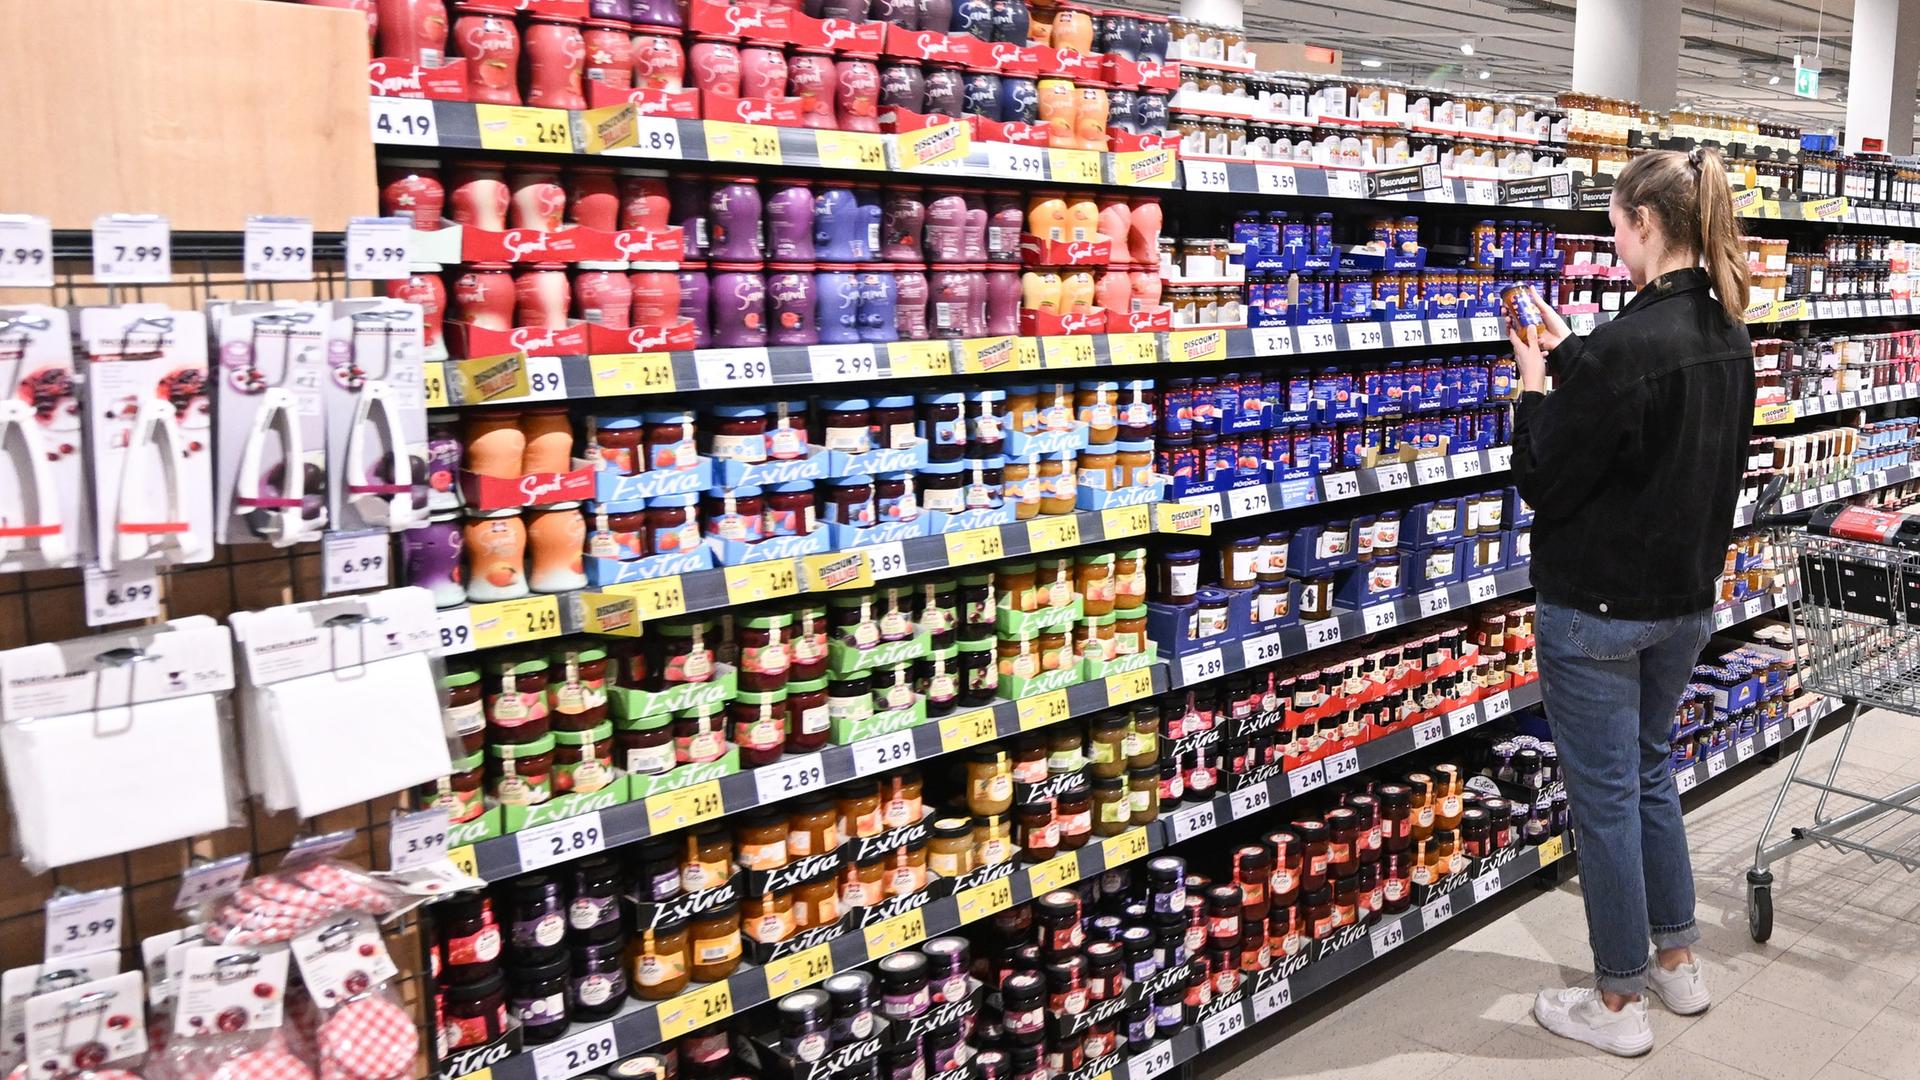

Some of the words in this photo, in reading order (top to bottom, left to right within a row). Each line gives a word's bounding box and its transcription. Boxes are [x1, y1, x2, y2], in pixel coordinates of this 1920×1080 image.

[726, 9, 762, 34] Samt
[823, 20, 855, 48] Samt
[918, 28, 949, 58] Samt
[992, 39, 1019, 66] Samt
[1056, 49, 1082, 72] Samt
[737, 100, 774, 123] Samt
[377, 113, 430, 136] 4.19
[536, 123, 566, 144] 2.69
[753, 138, 777, 155] 2.69
[858, 144, 880, 163] 2.69
[1009, 155, 1039, 173] 2.99
[1081, 162, 1099, 177] 2.69
[1202, 172, 1225, 185] 3.59
[1272, 175, 1294, 188] 3.59
[1380, 173, 1418, 187] Besonderes
[1510, 184, 1547, 196] Besonderes
[114, 246, 162, 262] 7.99
[263, 246, 305, 262] 9.99
[365, 247, 404, 262] 9.99
[504, 231, 550, 261] Samt
[615, 231, 654, 261] Samt
[1068, 242, 1094, 264] Samt
[1061, 314, 1087, 335] Samt
[1129, 312, 1153, 332] Samt
[1482, 326, 1498, 336] 2.79
[510, 329, 555, 351] Samt
[1314, 335, 1333, 347] 3.19
[1362, 332, 1380, 343] 2.99
[1404, 330, 1422, 341] 2.79
[1441, 327, 1458, 339] 2.79
[1139, 343, 1153, 358] 2.69
[1268, 337, 1289, 349] 2.79
[927, 354, 947, 368] 2.69
[1019, 349, 1036, 364] 2.69
[1076, 346, 1092, 361] 2.69
[726, 361, 765, 380] 2.89
[836, 358, 872, 374] 2.99
[644, 367, 669, 385] 2.69
[1023, 432, 1082, 452] Extra
[842, 450, 917, 474] Extra
[1464, 460, 1478, 472] 3.19
[741, 462, 820, 485] Extra
[1389, 472, 1408, 485] 2.99
[1428, 467, 1444, 478] 2.99
[612, 471, 701, 499] Extra
[1338, 482, 1356, 495] 2.79
[1103, 485, 1157, 506] Extra
[1245, 496, 1267, 510] 2.79
[941, 507, 1009, 530] Extra
[1131, 515, 1147, 529] 2.69
[852, 522, 921, 543] Extra
[1060, 524, 1077, 541] 2.69
[744, 539, 820, 562] Extra
[981, 537, 998, 554] 2.69
[343, 556, 382, 573] 6.99
[615, 555, 704, 582] Extra
[771, 571, 793, 589] 2.69
[107, 585, 152, 604] 6.99
[654, 589, 678, 609] 2.69
[1479, 584, 1495, 598] 2.89
[1430, 597, 1448, 612] 2.89
[1751, 604, 1760, 613] 2.29
[527, 610, 556, 631] 2.69
[1019, 607, 1078, 633] Extra
[1376, 612, 1394, 626] 2.89
[1319, 627, 1338, 643] 2.89
[854, 642, 922, 670] Extra
[1258, 643, 1279, 660] 2.89
[1198, 660, 1220, 677] 2.89
[1021, 668, 1077, 697] Extra
[1135, 678, 1150, 693] 2.69
[641, 684, 727, 713] Extra
[1050, 699, 1066, 715] 2.69
[1494, 698, 1510, 712] 2.49
[848, 710, 916, 743] Extra
[975, 722, 992, 737] 2.69
[1238, 710, 1281, 736] Extra
[1460, 713, 1475, 727] 2.89
[1425, 724, 1441, 741] 2.89
[1770, 732, 1779, 741] 2.29
[877, 743, 910, 763] 2.89
[1172, 730, 1220, 758] Extra
[1743, 745, 1753, 755] 2.29
[1337, 759, 1357, 774] 2.49
[1715, 759, 1724, 770] 2.29
[782, 768, 819, 790] 2.89
[1236, 765, 1279, 790] Extra
[1302, 769, 1323, 787] 2.49
[1685, 775, 1694, 787] 2.29
[1027, 774, 1085, 803] Extra
[694, 791, 718, 814] 2.69
[1245, 793, 1268, 809] 2.89
[1190, 814, 1214, 831] 2.89
[408, 833, 445, 854] 3.99
[551, 829, 599, 854] 2.89
[857, 824, 926, 861] Extra
[1131, 838, 1145, 853] 2.69
[1060, 861, 1076, 877] 2.69
[1480, 847, 1517, 876] Extra
[764, 853, 840, 894] Extra
[952, 861, 1014, 895] Extra
[1425, 873, 1471, 903] Extra
[1484, 878, 1500, 892] 4.19
[650, 884, 734, 927] Extra
[991, 892, 1008, 907] 2.69
[860, 891, 931, 928] Extra
[1435, 904, 1450, 919] 4.19
[66, 919, 114, 940] 3.99
[902, 920, 921, 940] 2.69
[1384, 931, 1402, 946] 4.39
[770, 926, 844, 961] Extra
[1319, 925, 1367, 960] Extra
[807, 957, 829, 977] 2.69
[1254, 954, 1308, 993] Extra
[1140, 964, 1191, 1000] Extra
[703, 995, 728, 1015] 2.69
[1197, 989, 1244, 1022] Extra
[1269, 986, 1288, 1008] 4.19
[906, 1000, 974, 1040] Extra
[1071, 1000, 1127, 1033] Extra
[1219, 1015, 1242, 1035] 2.89
[566, 1040, 611, 1068] 2.89
[808, 1039, 881, 1080] Extra
[1144, 1051, 1170, 1072] 2.99
